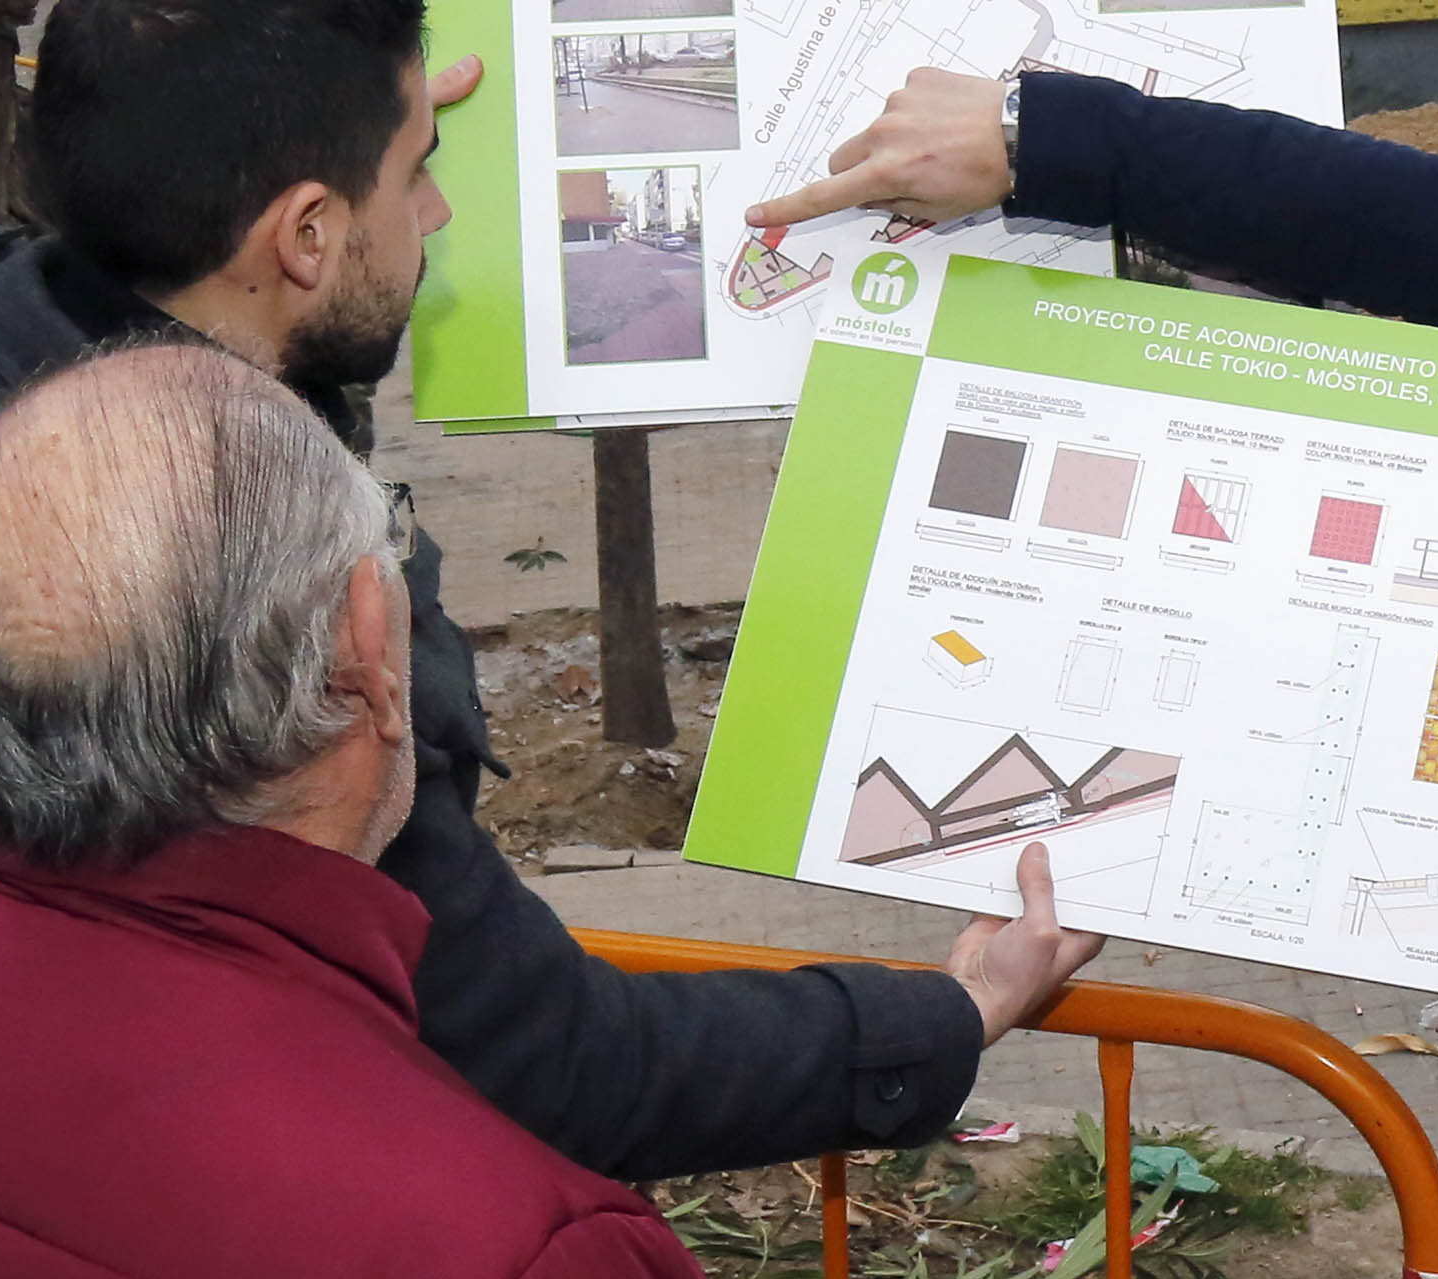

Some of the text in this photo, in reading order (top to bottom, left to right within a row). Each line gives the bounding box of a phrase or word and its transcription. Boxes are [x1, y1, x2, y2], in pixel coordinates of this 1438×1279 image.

[754, 101, 787, 144] Calle
[777, 27, 826, 102] Agustina
[818, 5, 837, 29] de
[835, 316, 912, 337] móstoles
[1033, 299, 1156, 336] PROYECTO
[1160, 317, 1191, 341] DE
[1194, 324, 1438, 381] ACONDICIONAMIENTO
[1143, 342, 1214, 372] CALLE
[1218, 353, 1288, 382] TOKIO
[1305, 366, 1434, 408] MÓSTOLES,
[1169, 420, 1285, 444] DETALLE DE BALDOSA TERRAZO
[1305, 448, 1331, 459] COLOR
[1306, 440, 1339, 452] DETALLE
[1341, 445, 1351, 453] DE
[912, 564, 948, 579] DETALLE
[948, 570, 961, 579] DE
[1101, 597, 1193, 619] DETALLE DE BORDILLO
[1288, 597, 1318, 609] DETALLE
[1320, 602, 1330, 610] DE
